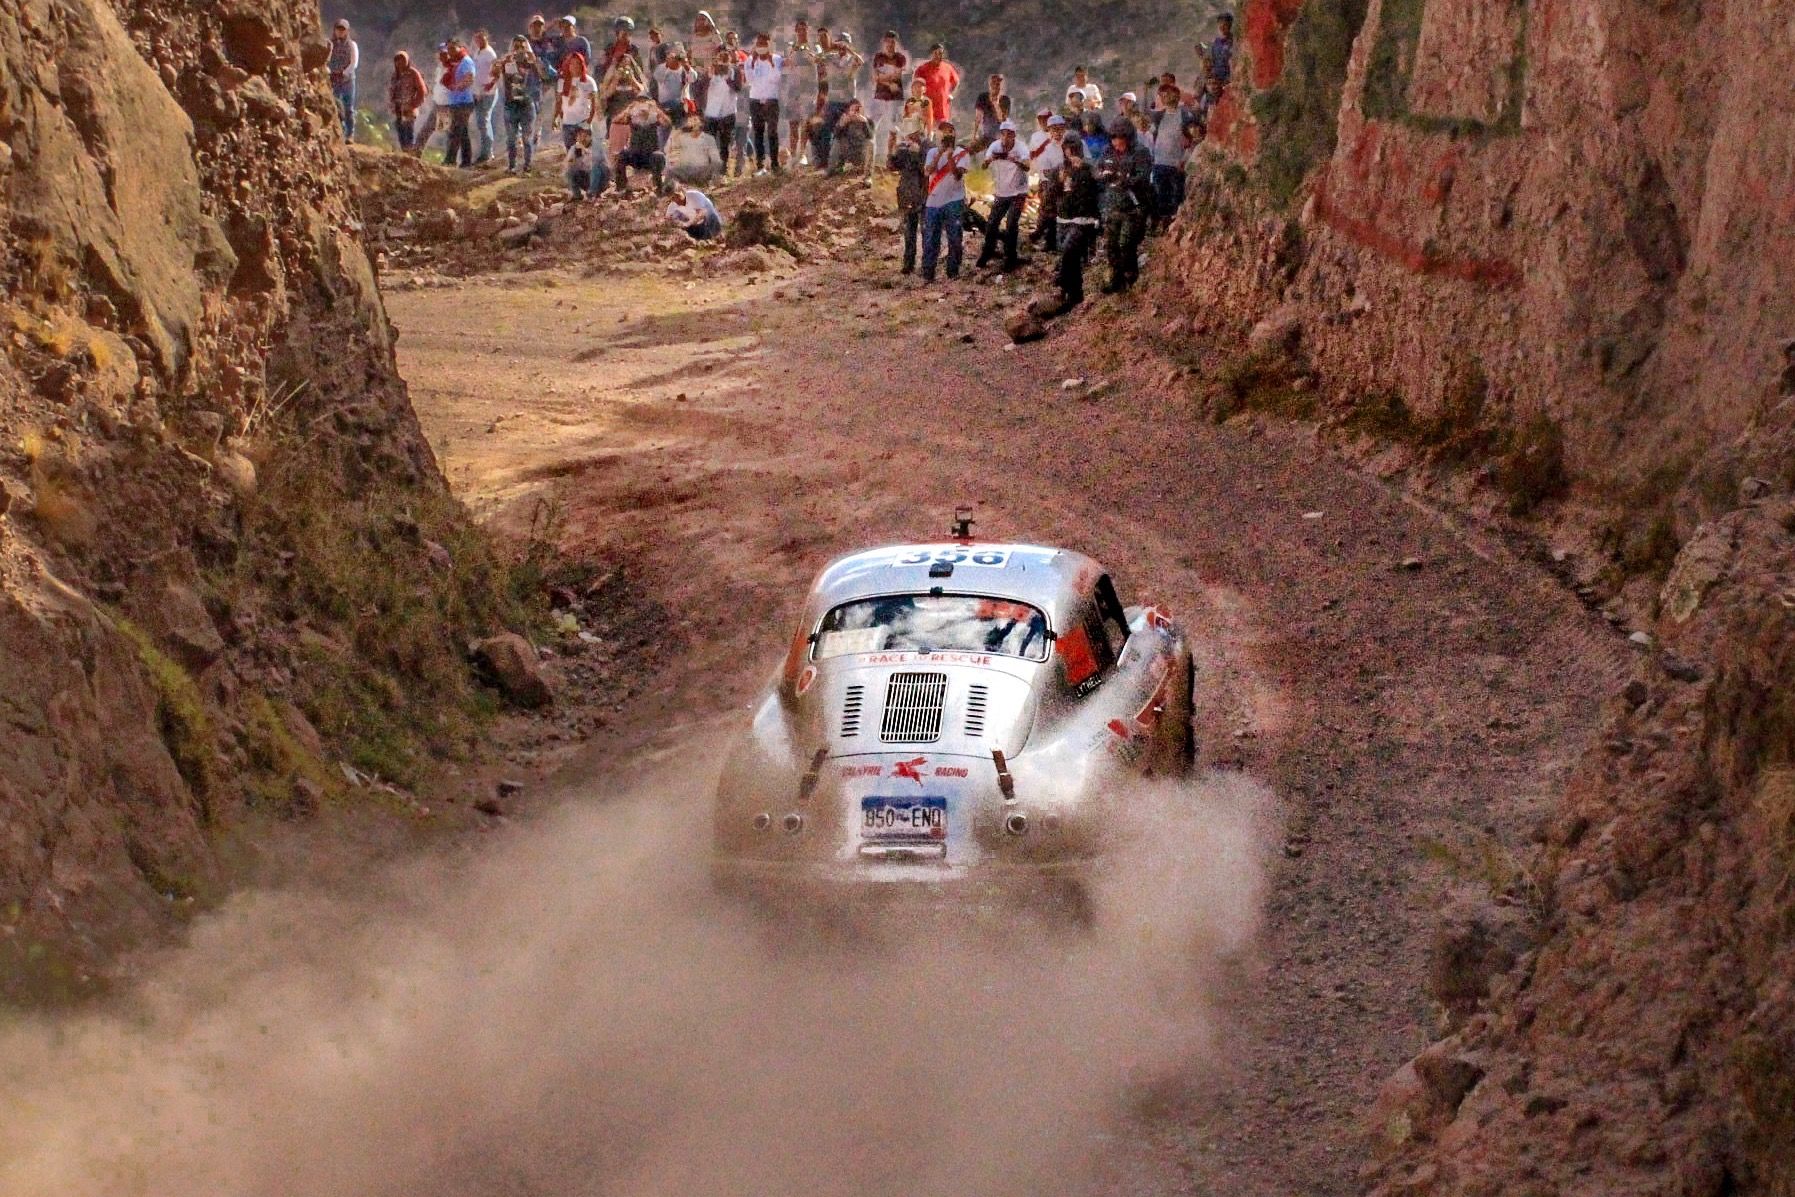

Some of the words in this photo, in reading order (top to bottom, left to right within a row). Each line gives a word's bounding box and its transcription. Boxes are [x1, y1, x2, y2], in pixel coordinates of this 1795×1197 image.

[900, 550, 1004, 565] 356
[868, 653, 907, 664] RACE
[931, 653, 992, 665] RESCUE
[934, 766, 969, 778] RACING
